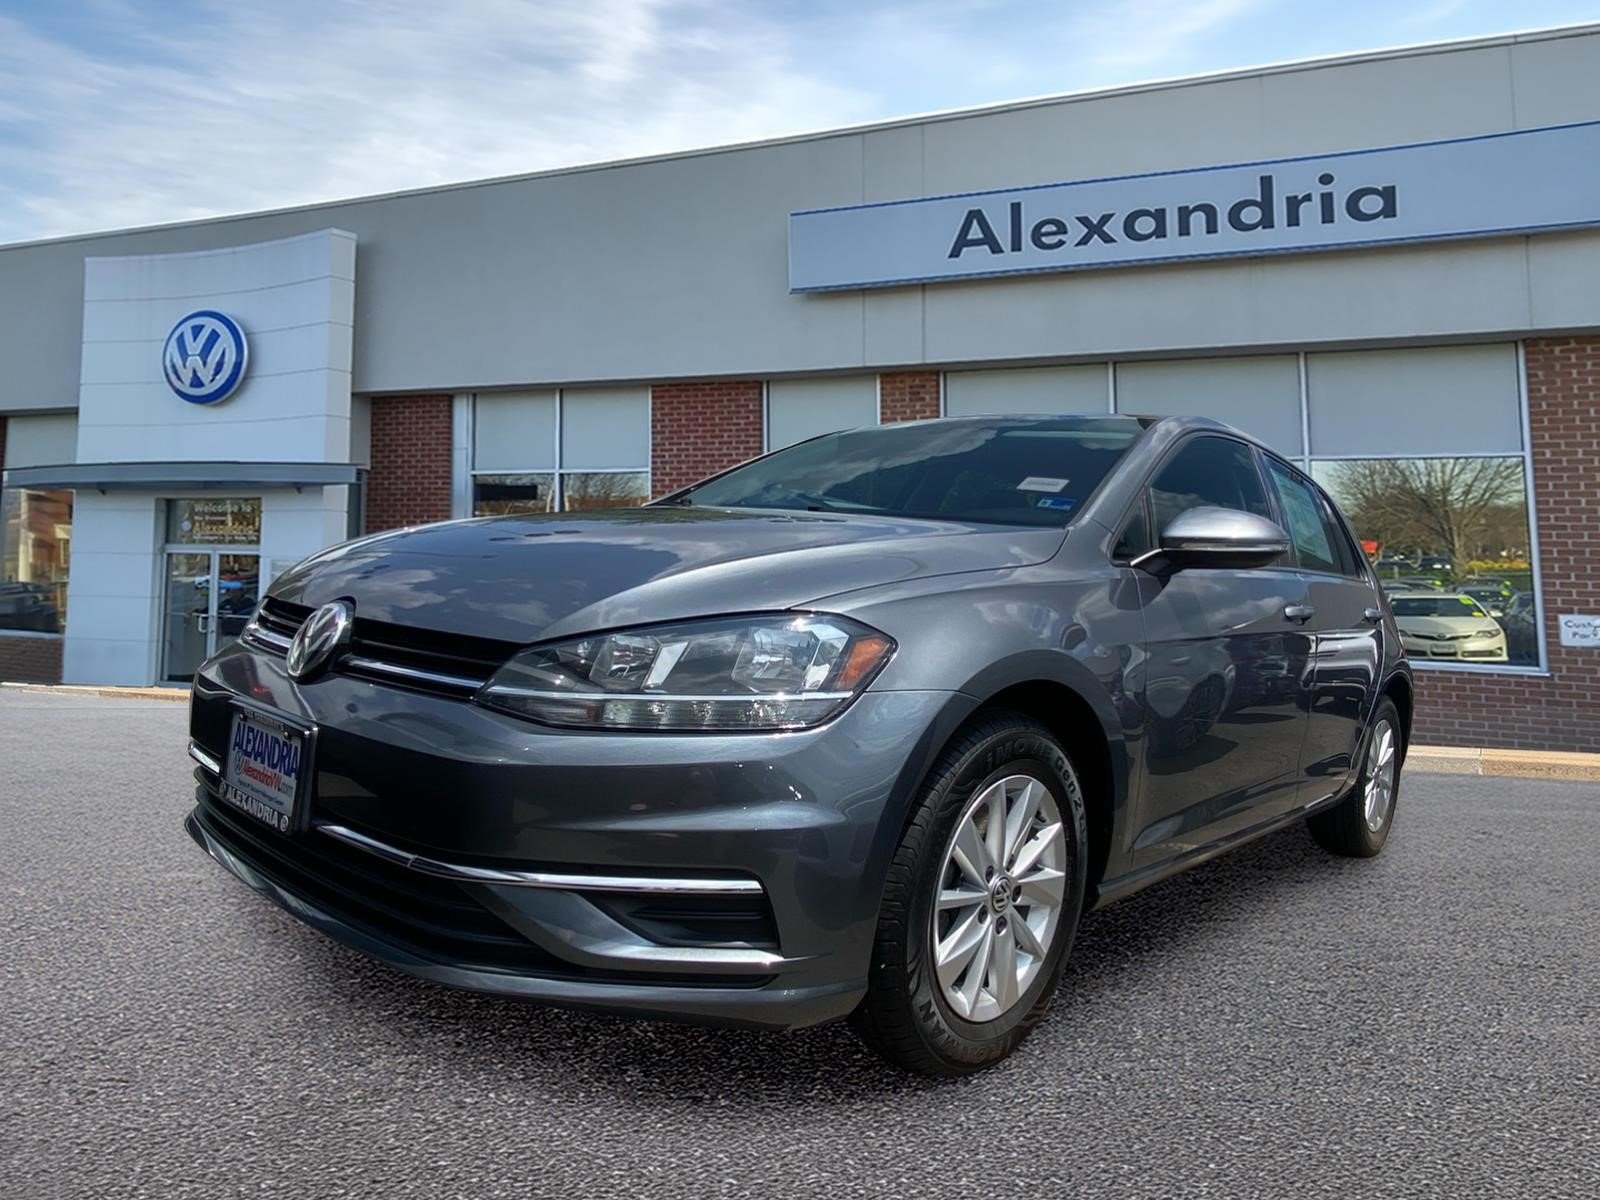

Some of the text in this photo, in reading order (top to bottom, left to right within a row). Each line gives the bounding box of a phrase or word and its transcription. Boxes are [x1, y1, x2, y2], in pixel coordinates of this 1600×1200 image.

[948, 172, 1397, 259] Alexandria
[164, 313, 242, 399] VW
[233, 721, 298, 777] ALEXANDRIA
[226, 786, 278, 827] ALEXANDRIA
